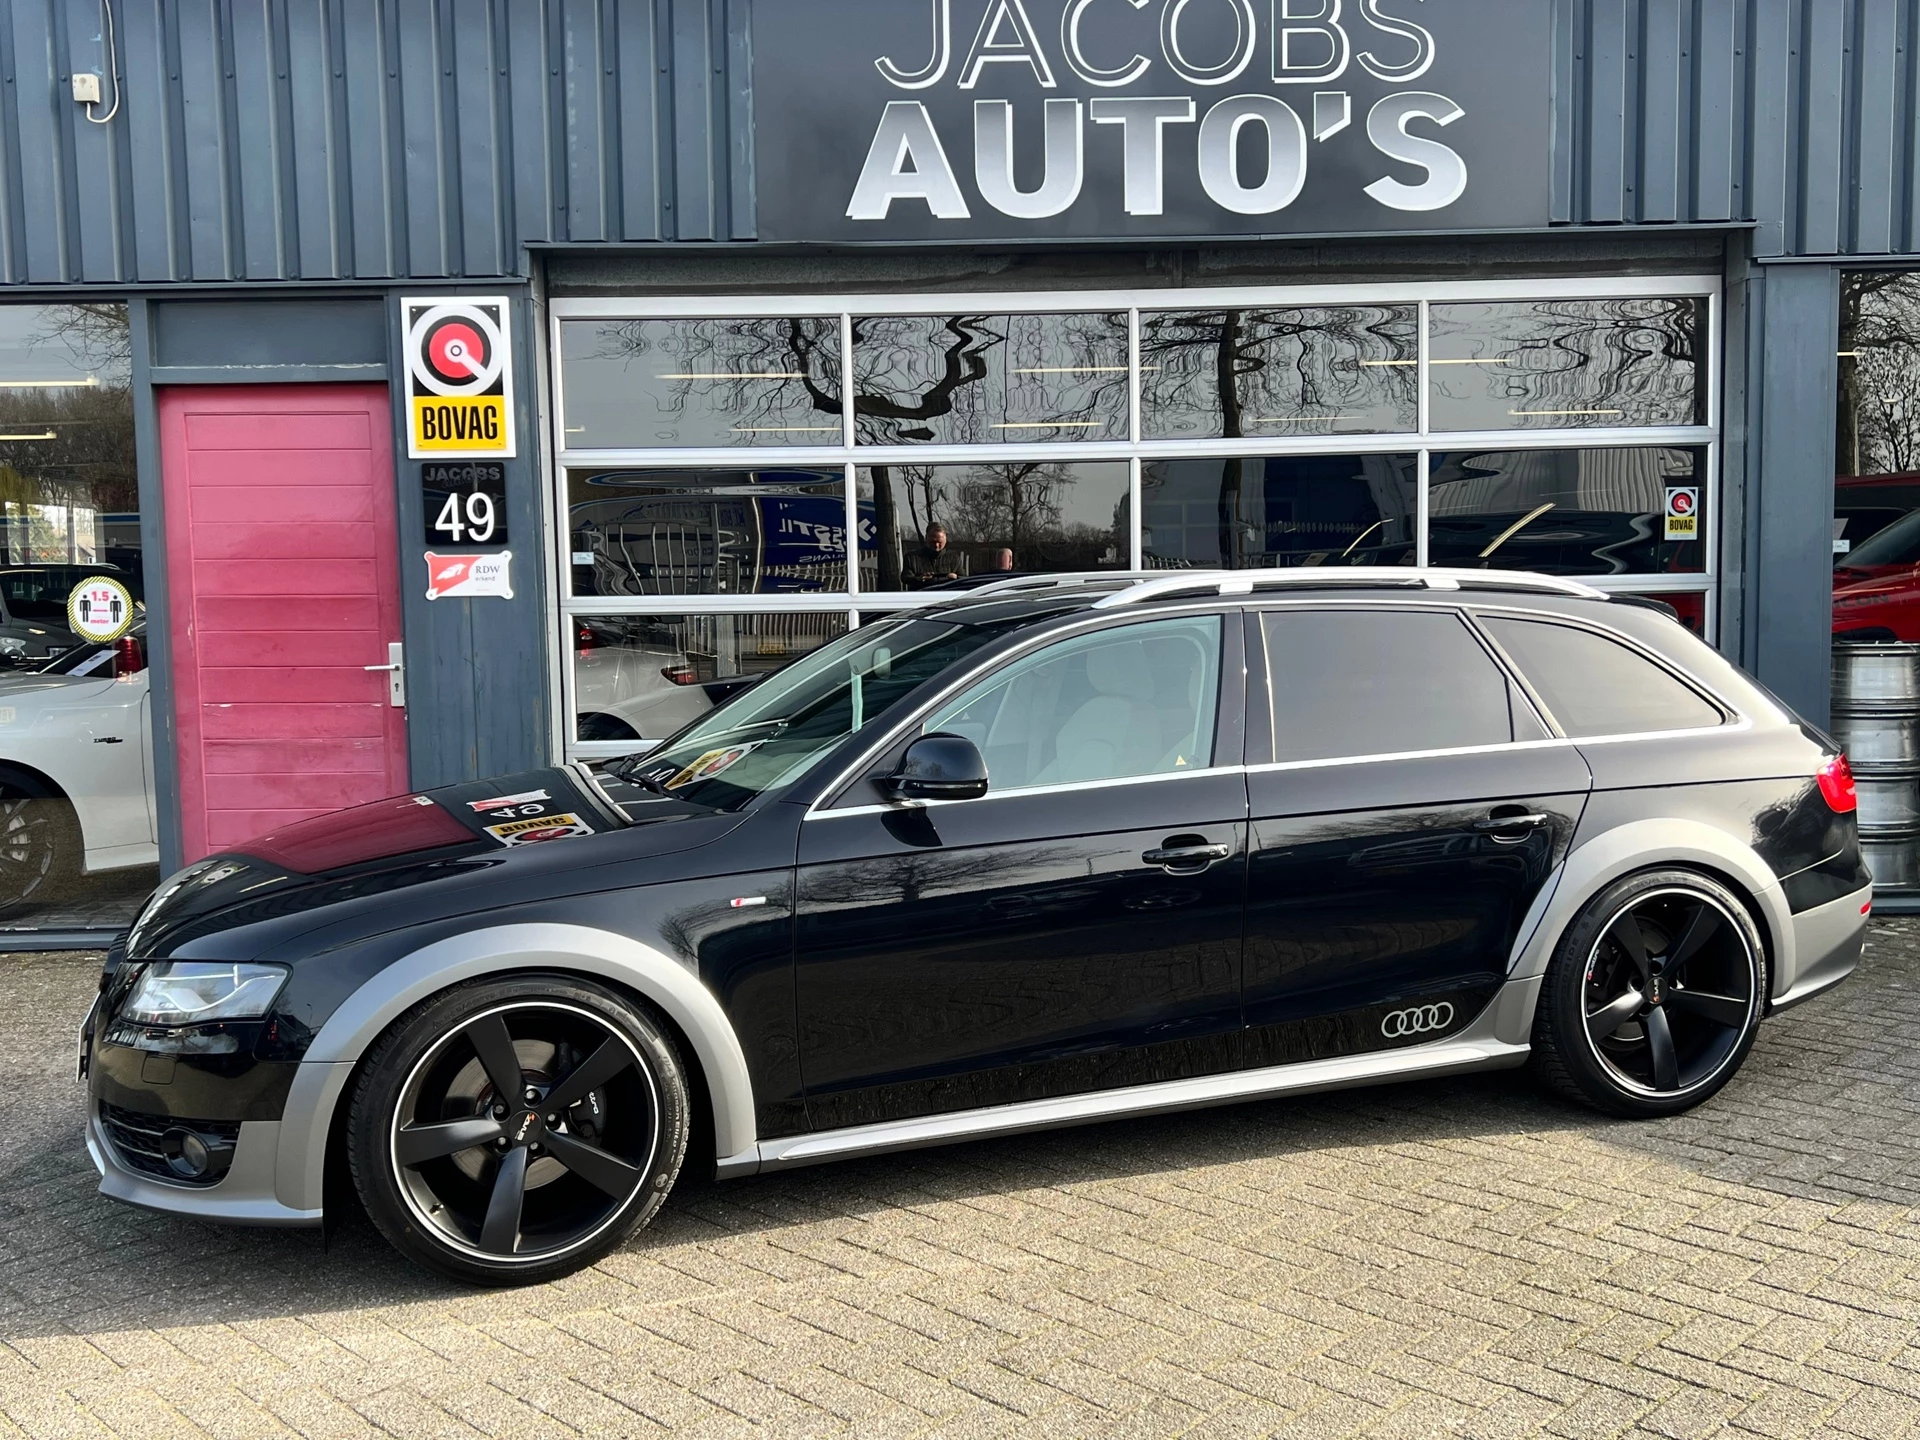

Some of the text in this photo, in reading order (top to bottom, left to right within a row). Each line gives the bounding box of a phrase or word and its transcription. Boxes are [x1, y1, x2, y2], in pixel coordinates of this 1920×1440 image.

[874, 0, 1436, 89] JACOBS
[845, 91, 1468, 219] AUTO'S
[422, 405, 498, 440] BOVAG
[424, 466, 501, 481] JACOBS
[435, 492, 495, 541] 49
[1669, 519, 1693, 531] BOVAG
[475, 565, 501, 574] RDW
[91, 591, 109, 602] 1.5
[1832, 594, 1890, 609] ICON
[588, 1091, 599, 1114] ttro
